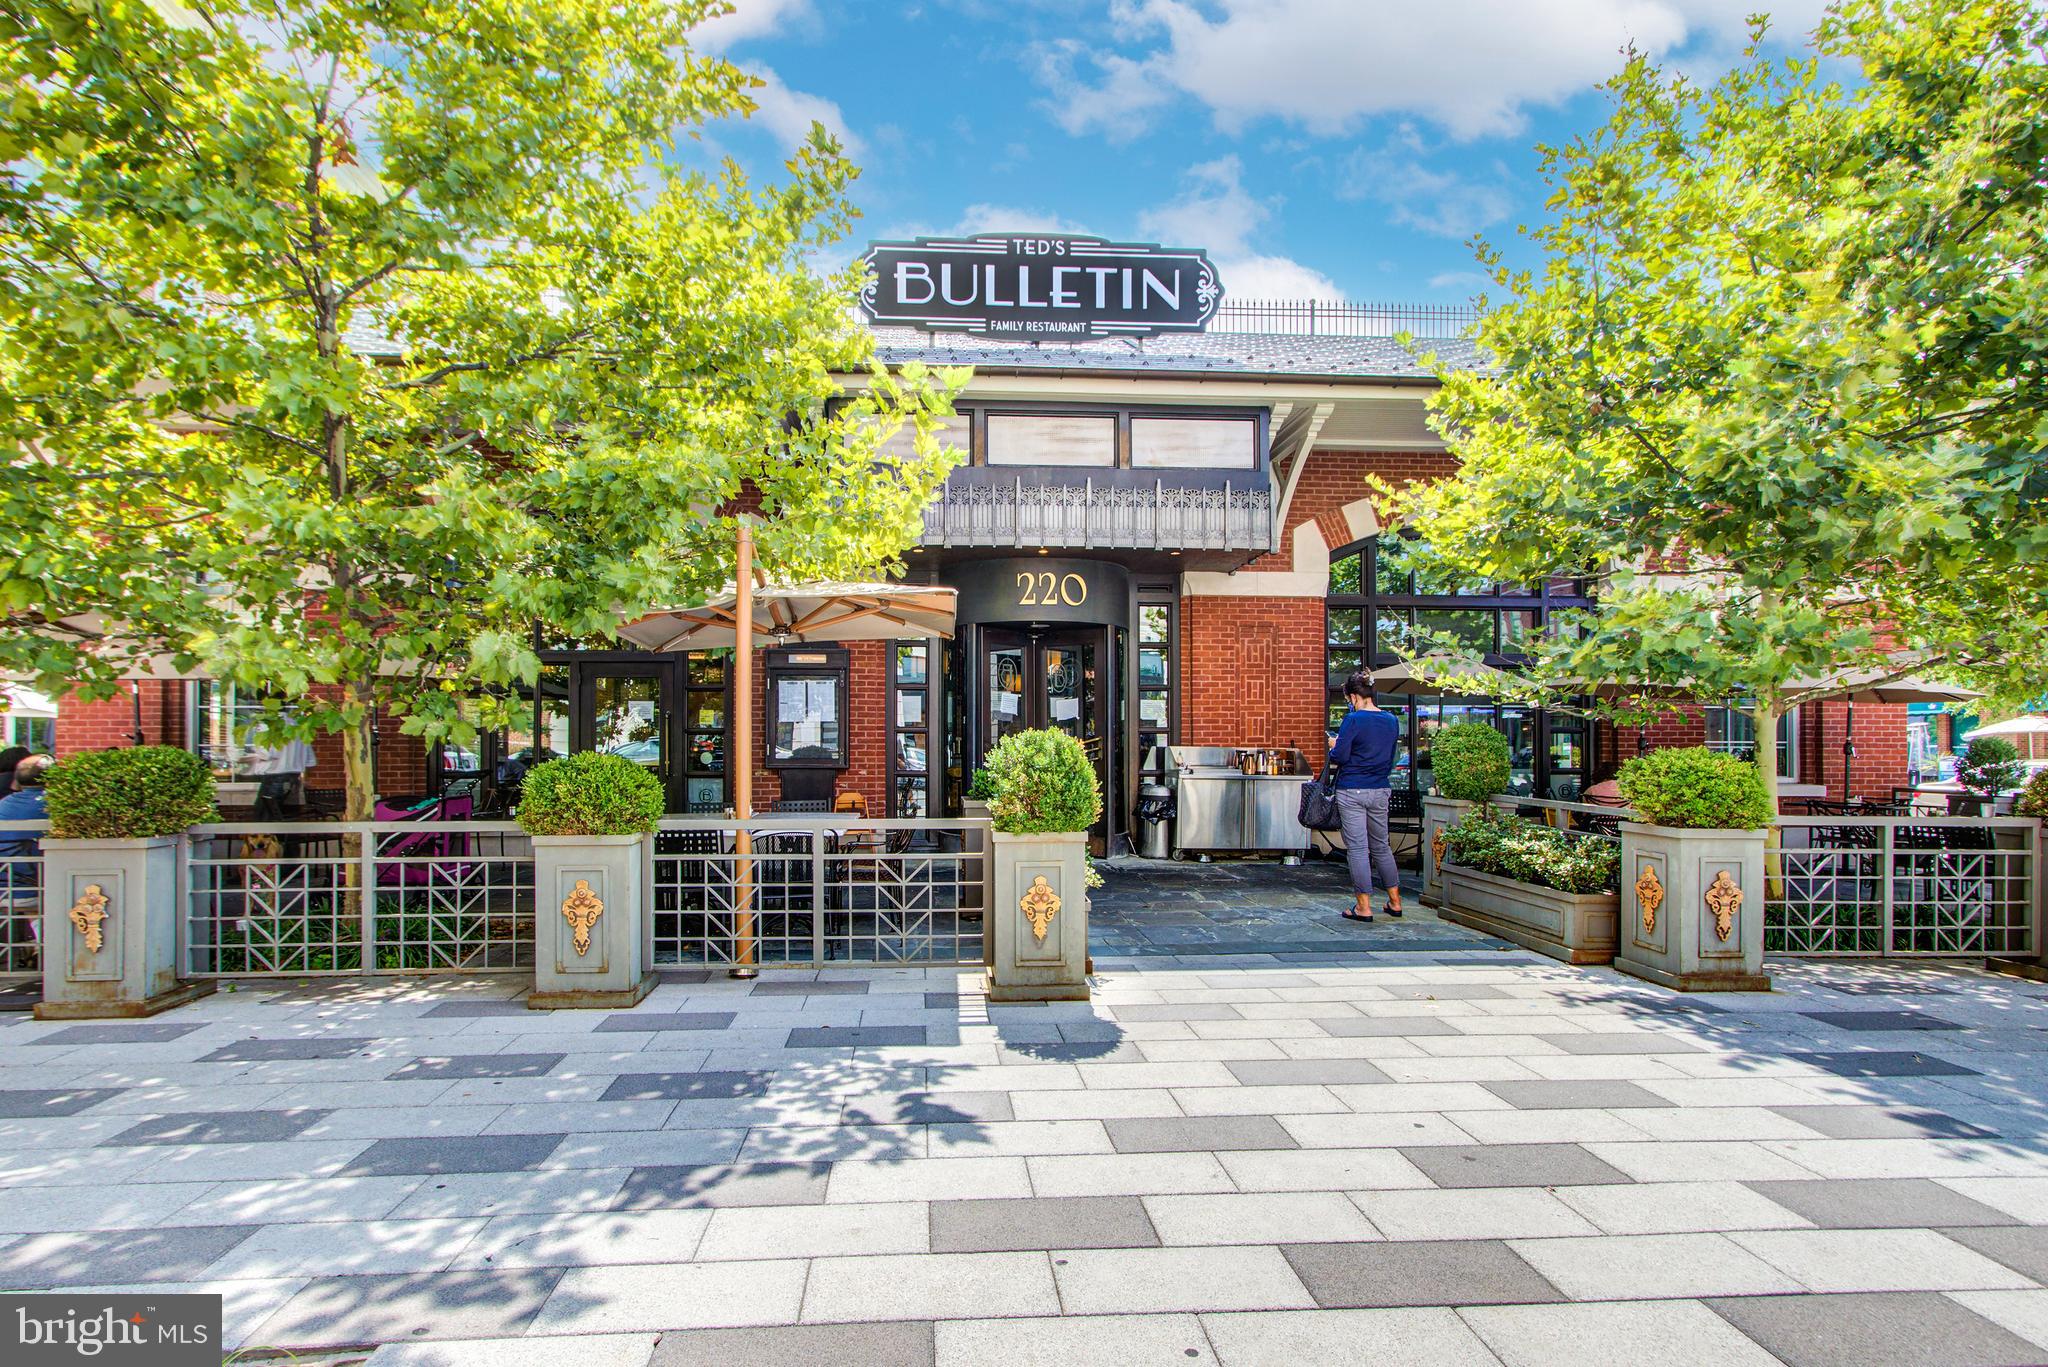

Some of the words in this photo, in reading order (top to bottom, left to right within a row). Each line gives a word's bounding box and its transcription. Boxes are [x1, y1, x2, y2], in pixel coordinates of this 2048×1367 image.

[1012, 239, 1066, 256] TED'S
[893, 261, 1181, 310] BULLETIN
[990, 320, 1024, 332] FAMILY
[1026, 321, 1087, 333] RESTAURANT
[1016, 572, 1088, 607] 220
